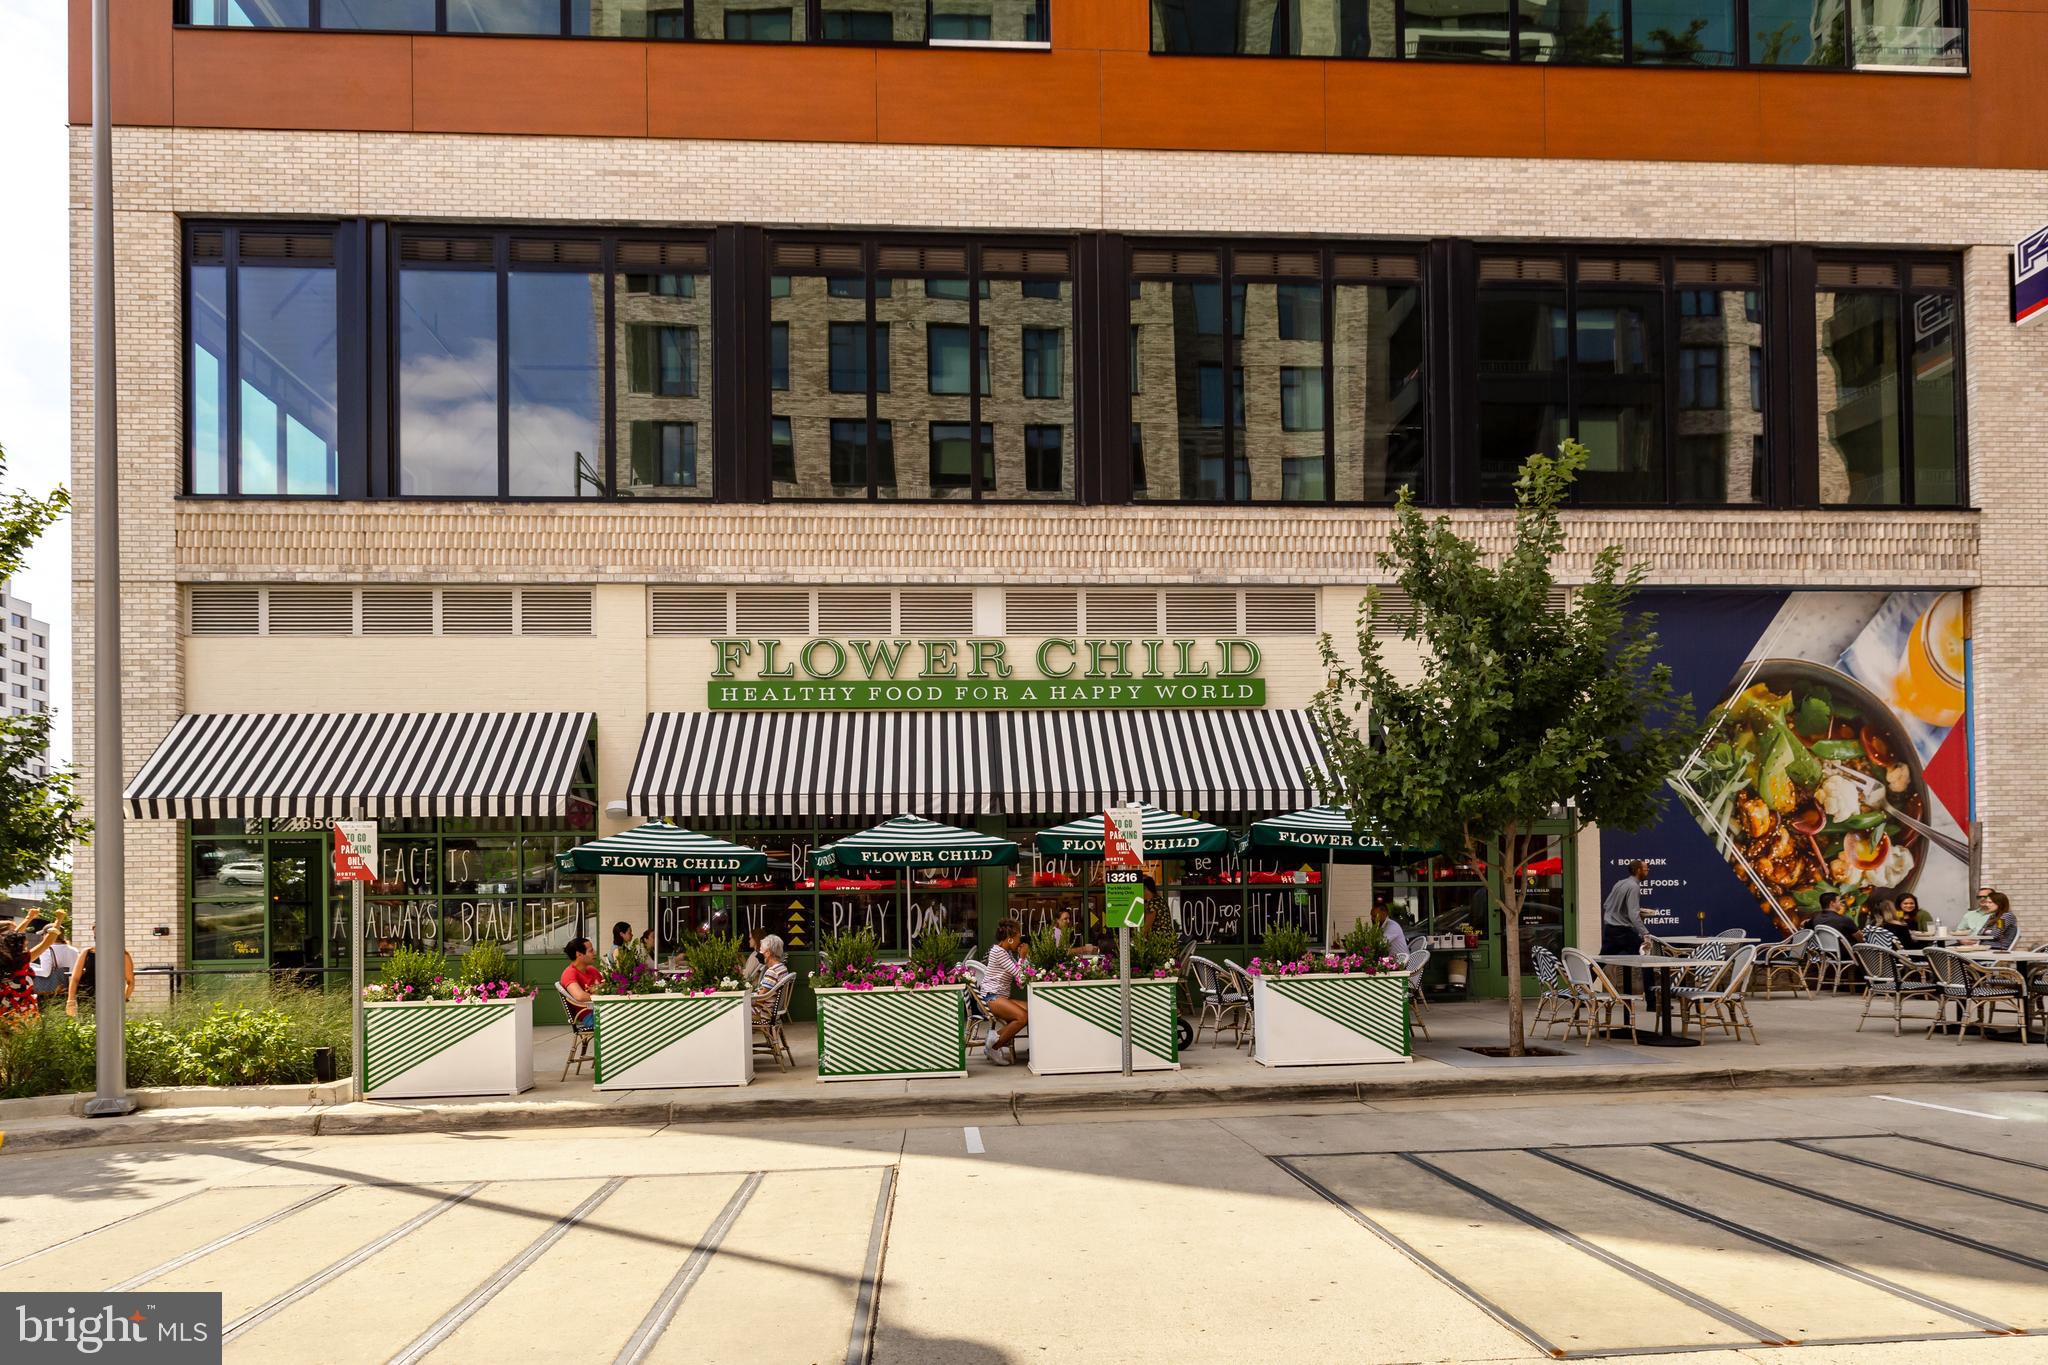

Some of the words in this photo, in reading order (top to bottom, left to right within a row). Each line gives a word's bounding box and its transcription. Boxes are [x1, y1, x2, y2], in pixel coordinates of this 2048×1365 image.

[710, 638, 1013, 680] FLOWER
[1035, 637, 1262, 679] CHILD
[720, 686, 856, 702] HEALTHY
[868, 686, 943, 701] FOOD
[955, 686, 1009, 701] FOR
[1019, 686, 1038, 700] A
[1050, 685, 1143, 700] HAPPY
[1154, 684, 1254, 699] WORLD
[1115, 819, 1123, 828] TO
[1124, 819, 1133, 828] GO
[346, 833, 355, 842] TO
[357, 833, 367, 842] GO
[1109, 830, 1138, 840] PARKING
[1278, 831, 1354, 846] FLOWER
[340, 844, 372, 855] PARKING
[1115, 842, 1132, 851] ONLY
[1142, 836, 1200, 850] CHILD
[347, 856, 366, 866] ONLY
[600, 856, 678, 869] FLOWER
[682, 858, 741, 870] CHILD
[861, 850, 934, 863] FLOWER
[938, 849, 993, 862] CHILD
[371, 848, 433, 886] EACE
[448, 848, 470, 884] IS
[1111, 872, 1138, 883] 3216
[1219, 904, 1241, 918] FOR
[365, 902, 437, 940] ALWAYS
[663, 905, 690, 944] OF
